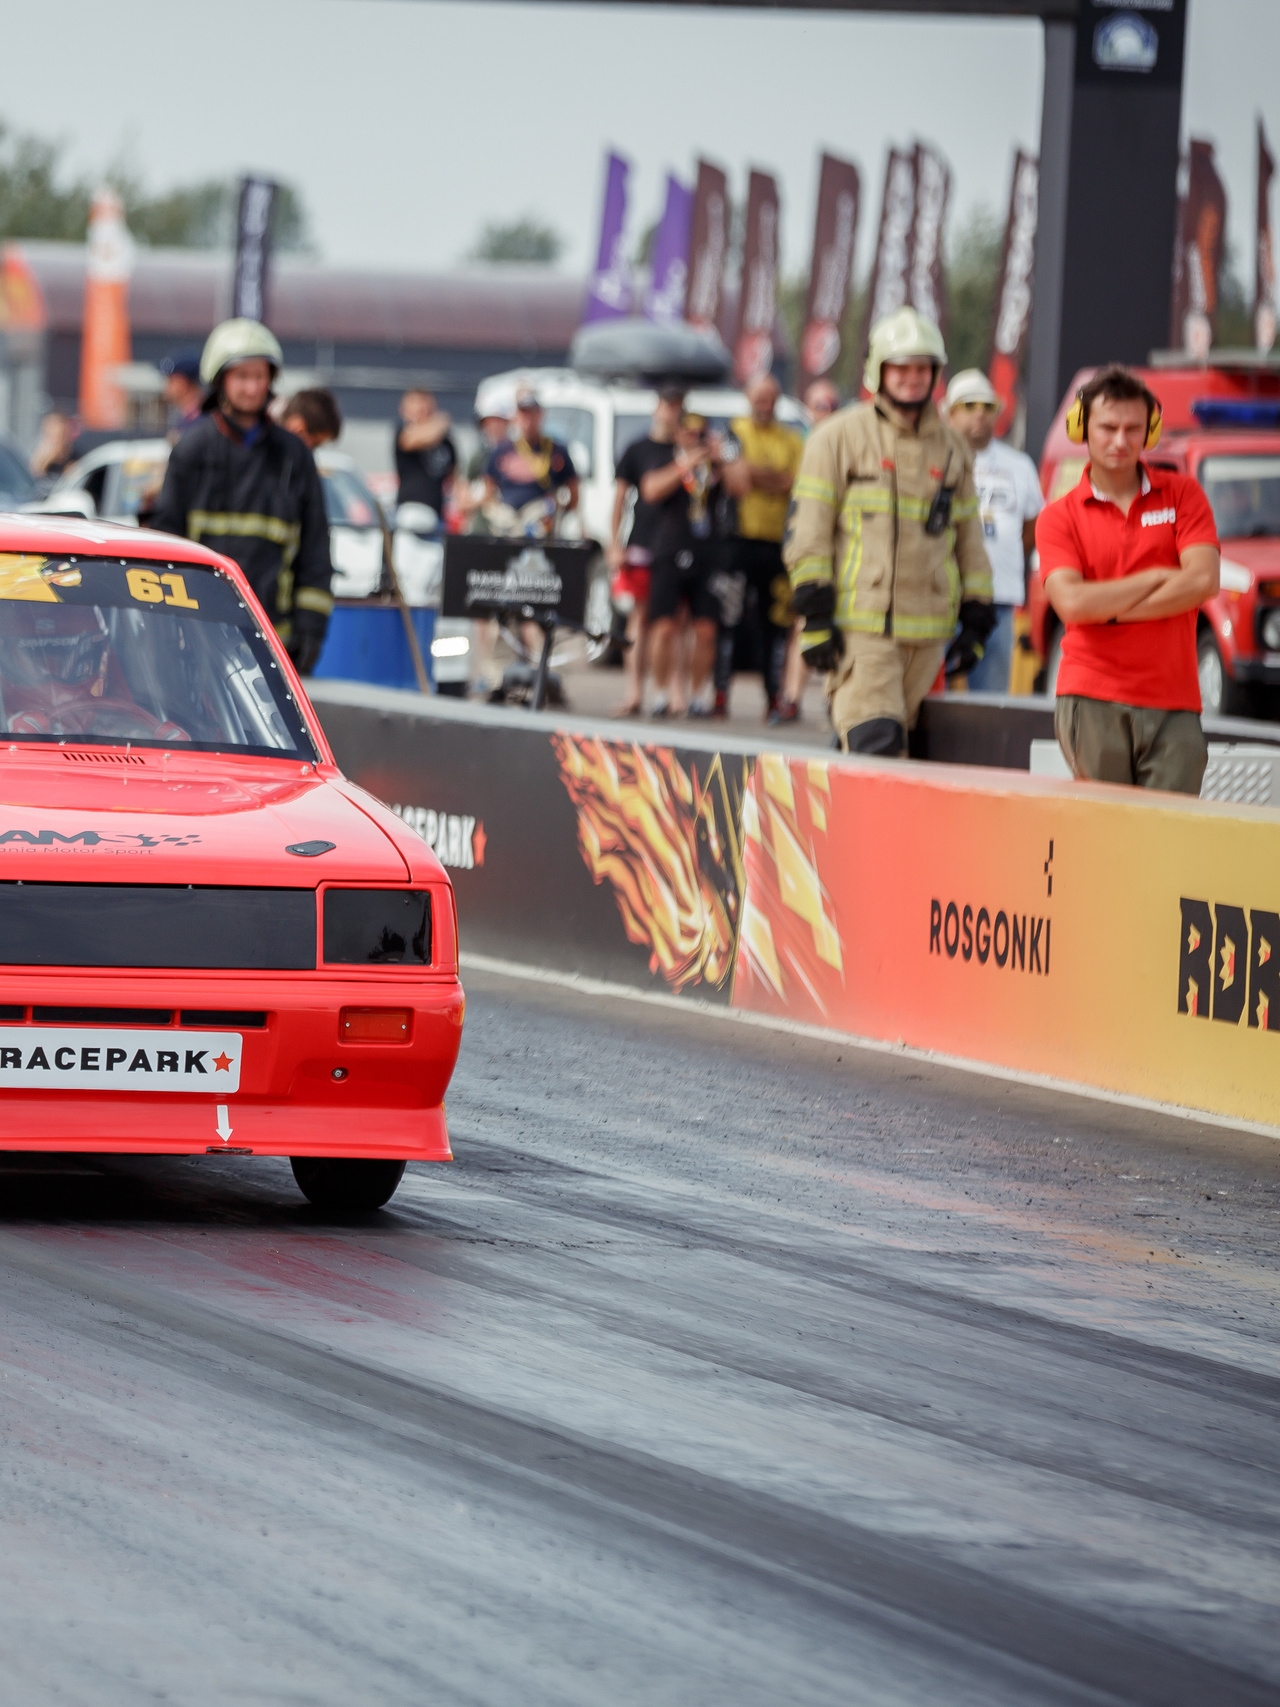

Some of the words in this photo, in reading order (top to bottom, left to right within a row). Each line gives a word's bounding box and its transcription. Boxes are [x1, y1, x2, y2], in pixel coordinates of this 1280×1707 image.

[125, 568, 199, 610] 61
[103, 847, 154, 856] Sport
[929, 896, 1052, 978] ROSGONKI
[0, 1046, 210, 1074] RACEPARK
